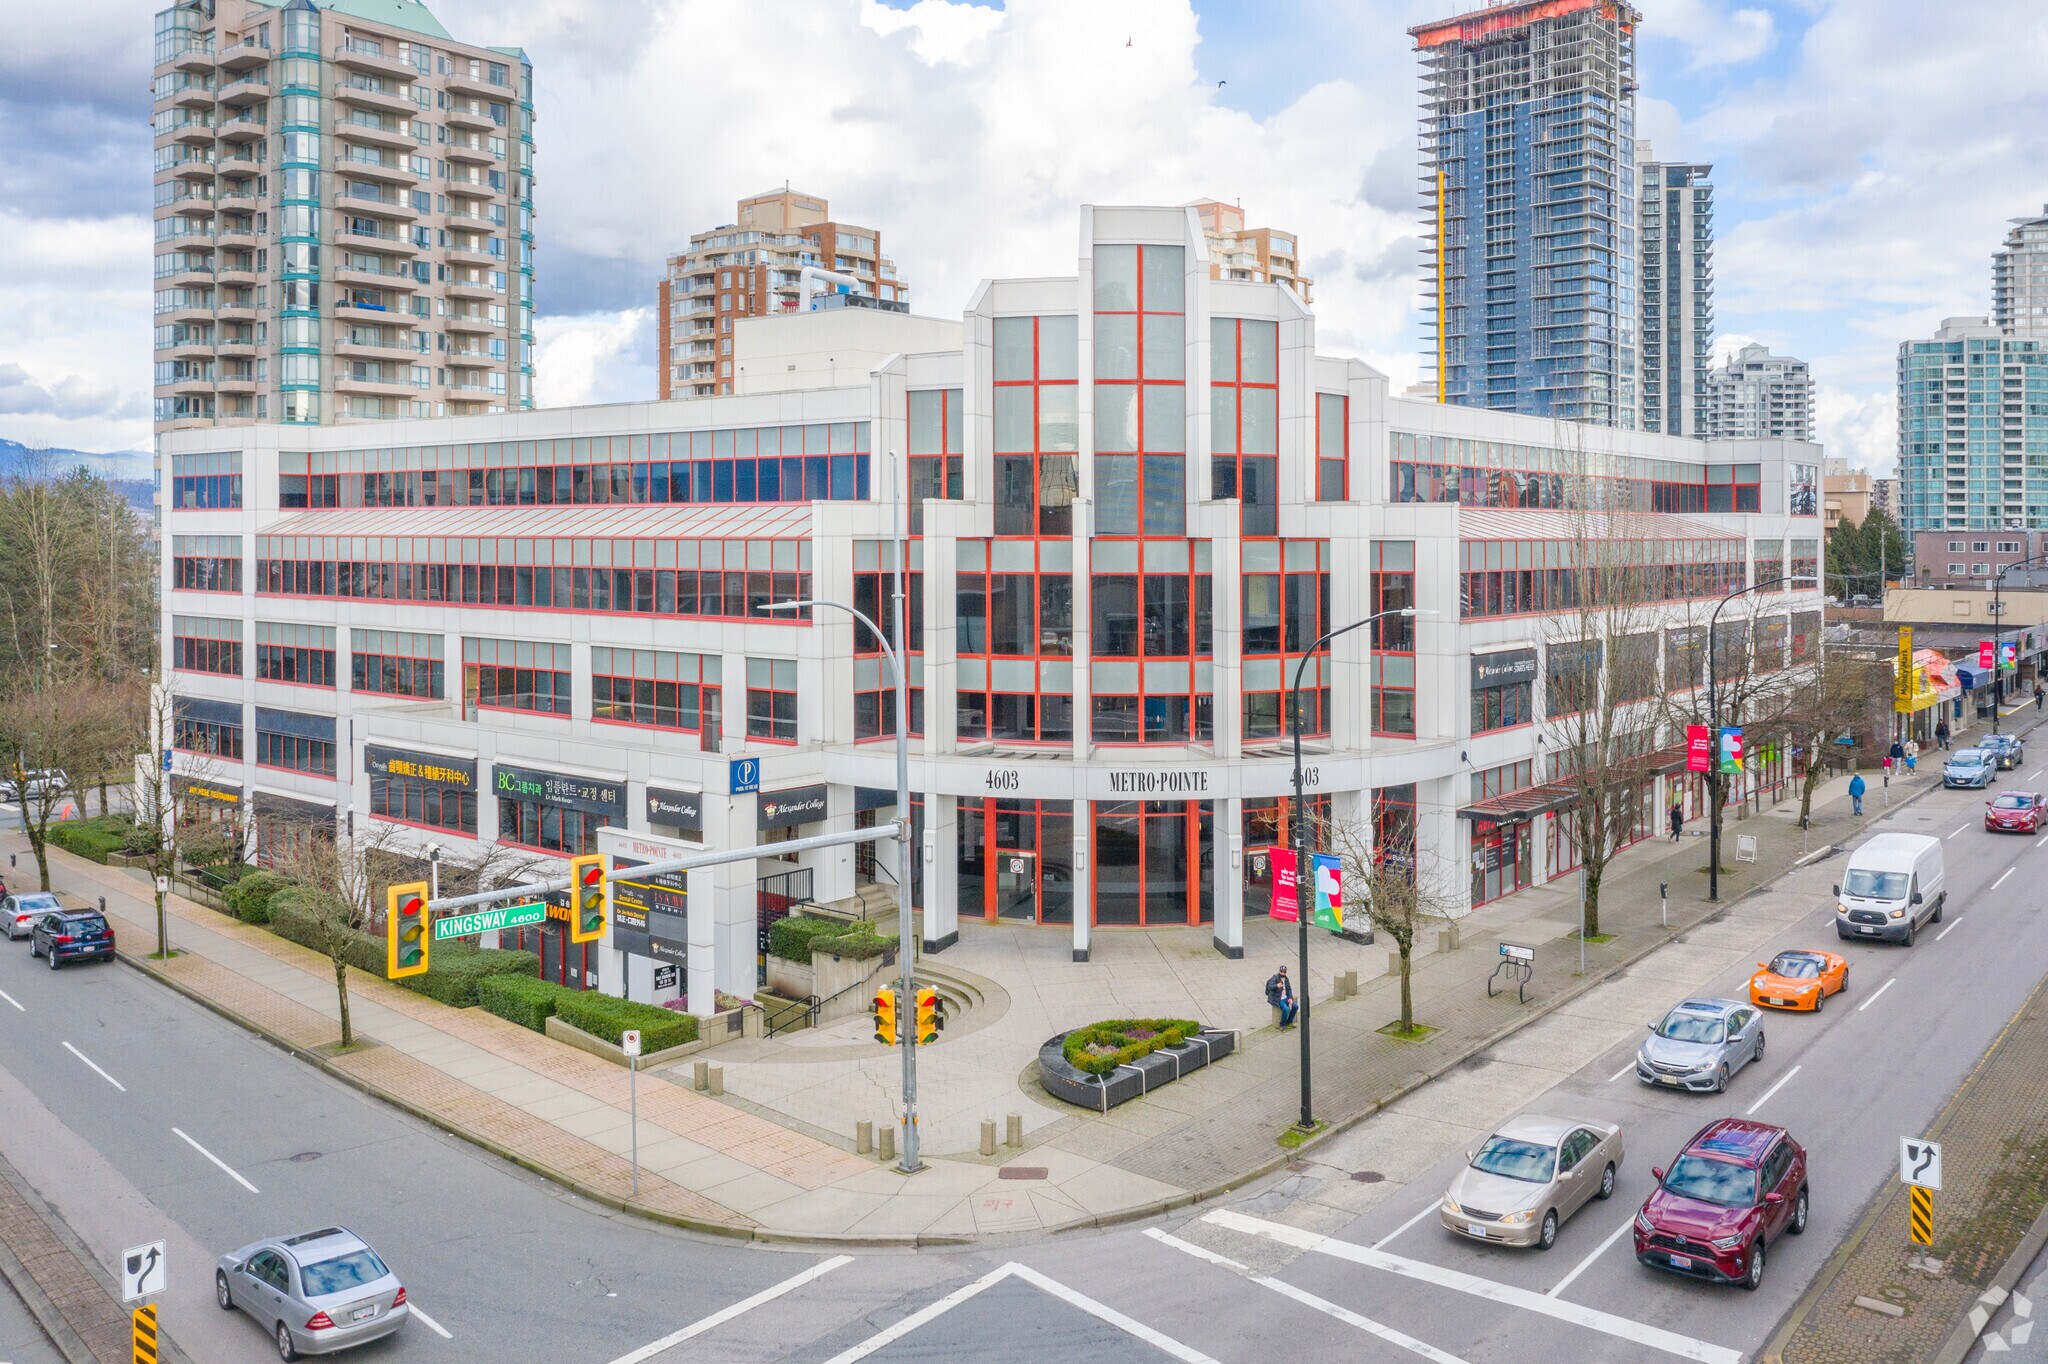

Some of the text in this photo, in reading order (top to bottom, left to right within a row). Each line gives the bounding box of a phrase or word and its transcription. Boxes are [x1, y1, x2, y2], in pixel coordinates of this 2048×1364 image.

[418, 765, 424, 777] &
[985, 769, 1019, 790] 4603
[498, 772, 515, 791] BC
[657, 801, 696, 818] Alexander College
[776, 799, 825, 816] Alexander College
[655, 904, 682, 914] SUSHI
[440, 911, 540, 937] KINGSWAY 4600
